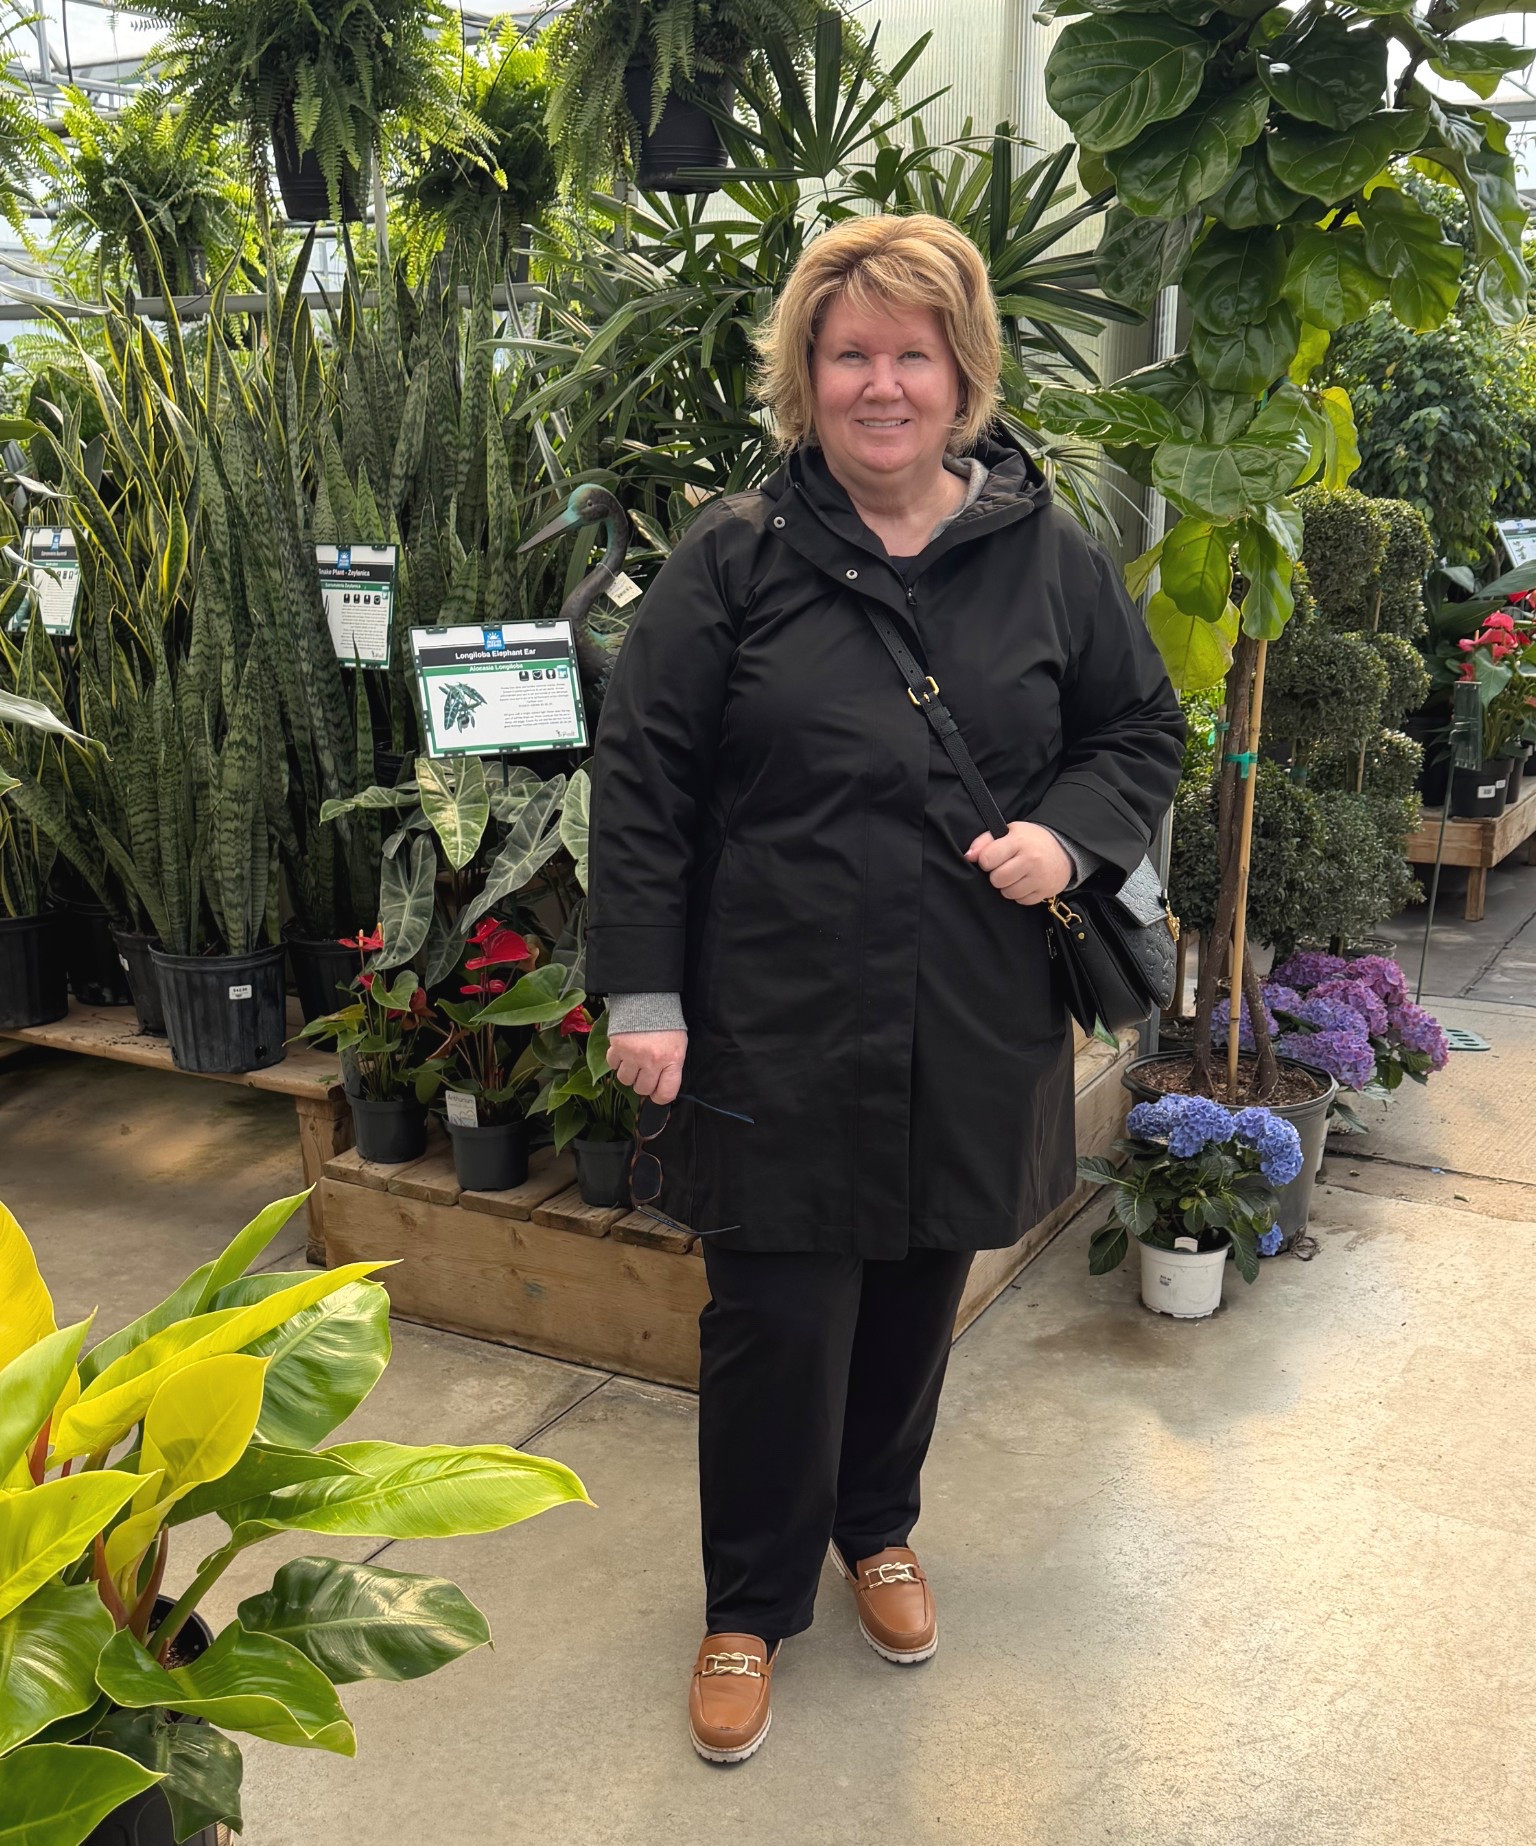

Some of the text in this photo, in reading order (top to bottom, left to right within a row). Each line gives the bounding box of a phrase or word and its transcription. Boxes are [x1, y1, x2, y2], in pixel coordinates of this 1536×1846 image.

[332, 568, 345, 576] Plant
[455, 651, 491, 660] Longiloba
[492, 649, 523, 658] Elephant
[495, 663, 523, 671] Longiloba
[448, 1094, 474, 1103] Anthurium
